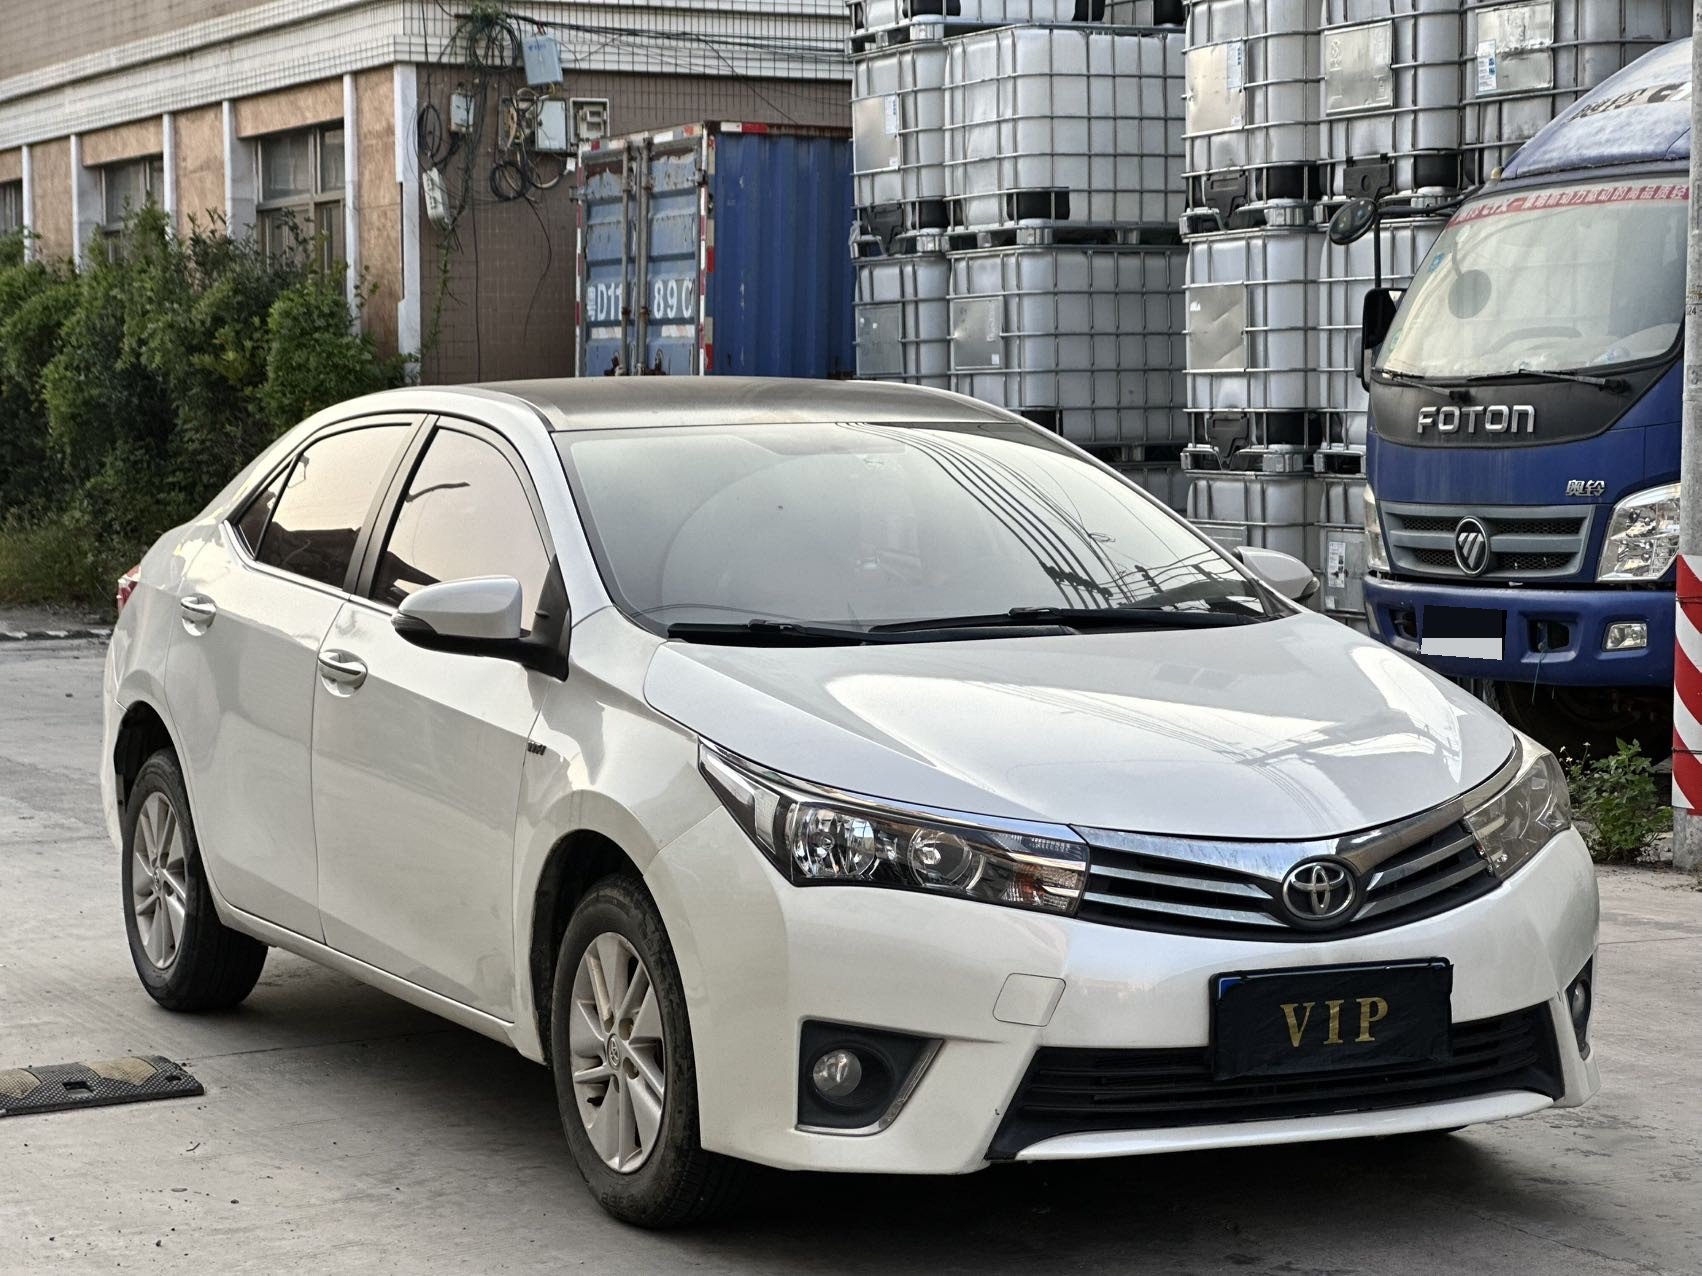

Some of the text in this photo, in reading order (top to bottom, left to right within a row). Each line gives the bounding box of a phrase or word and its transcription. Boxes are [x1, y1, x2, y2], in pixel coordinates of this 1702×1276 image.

[1417, 404, 1536, 434] FOTON
[1565, 479, 1605, 497] 奥铃
[1280, 996, 1389, 1048] VIP
